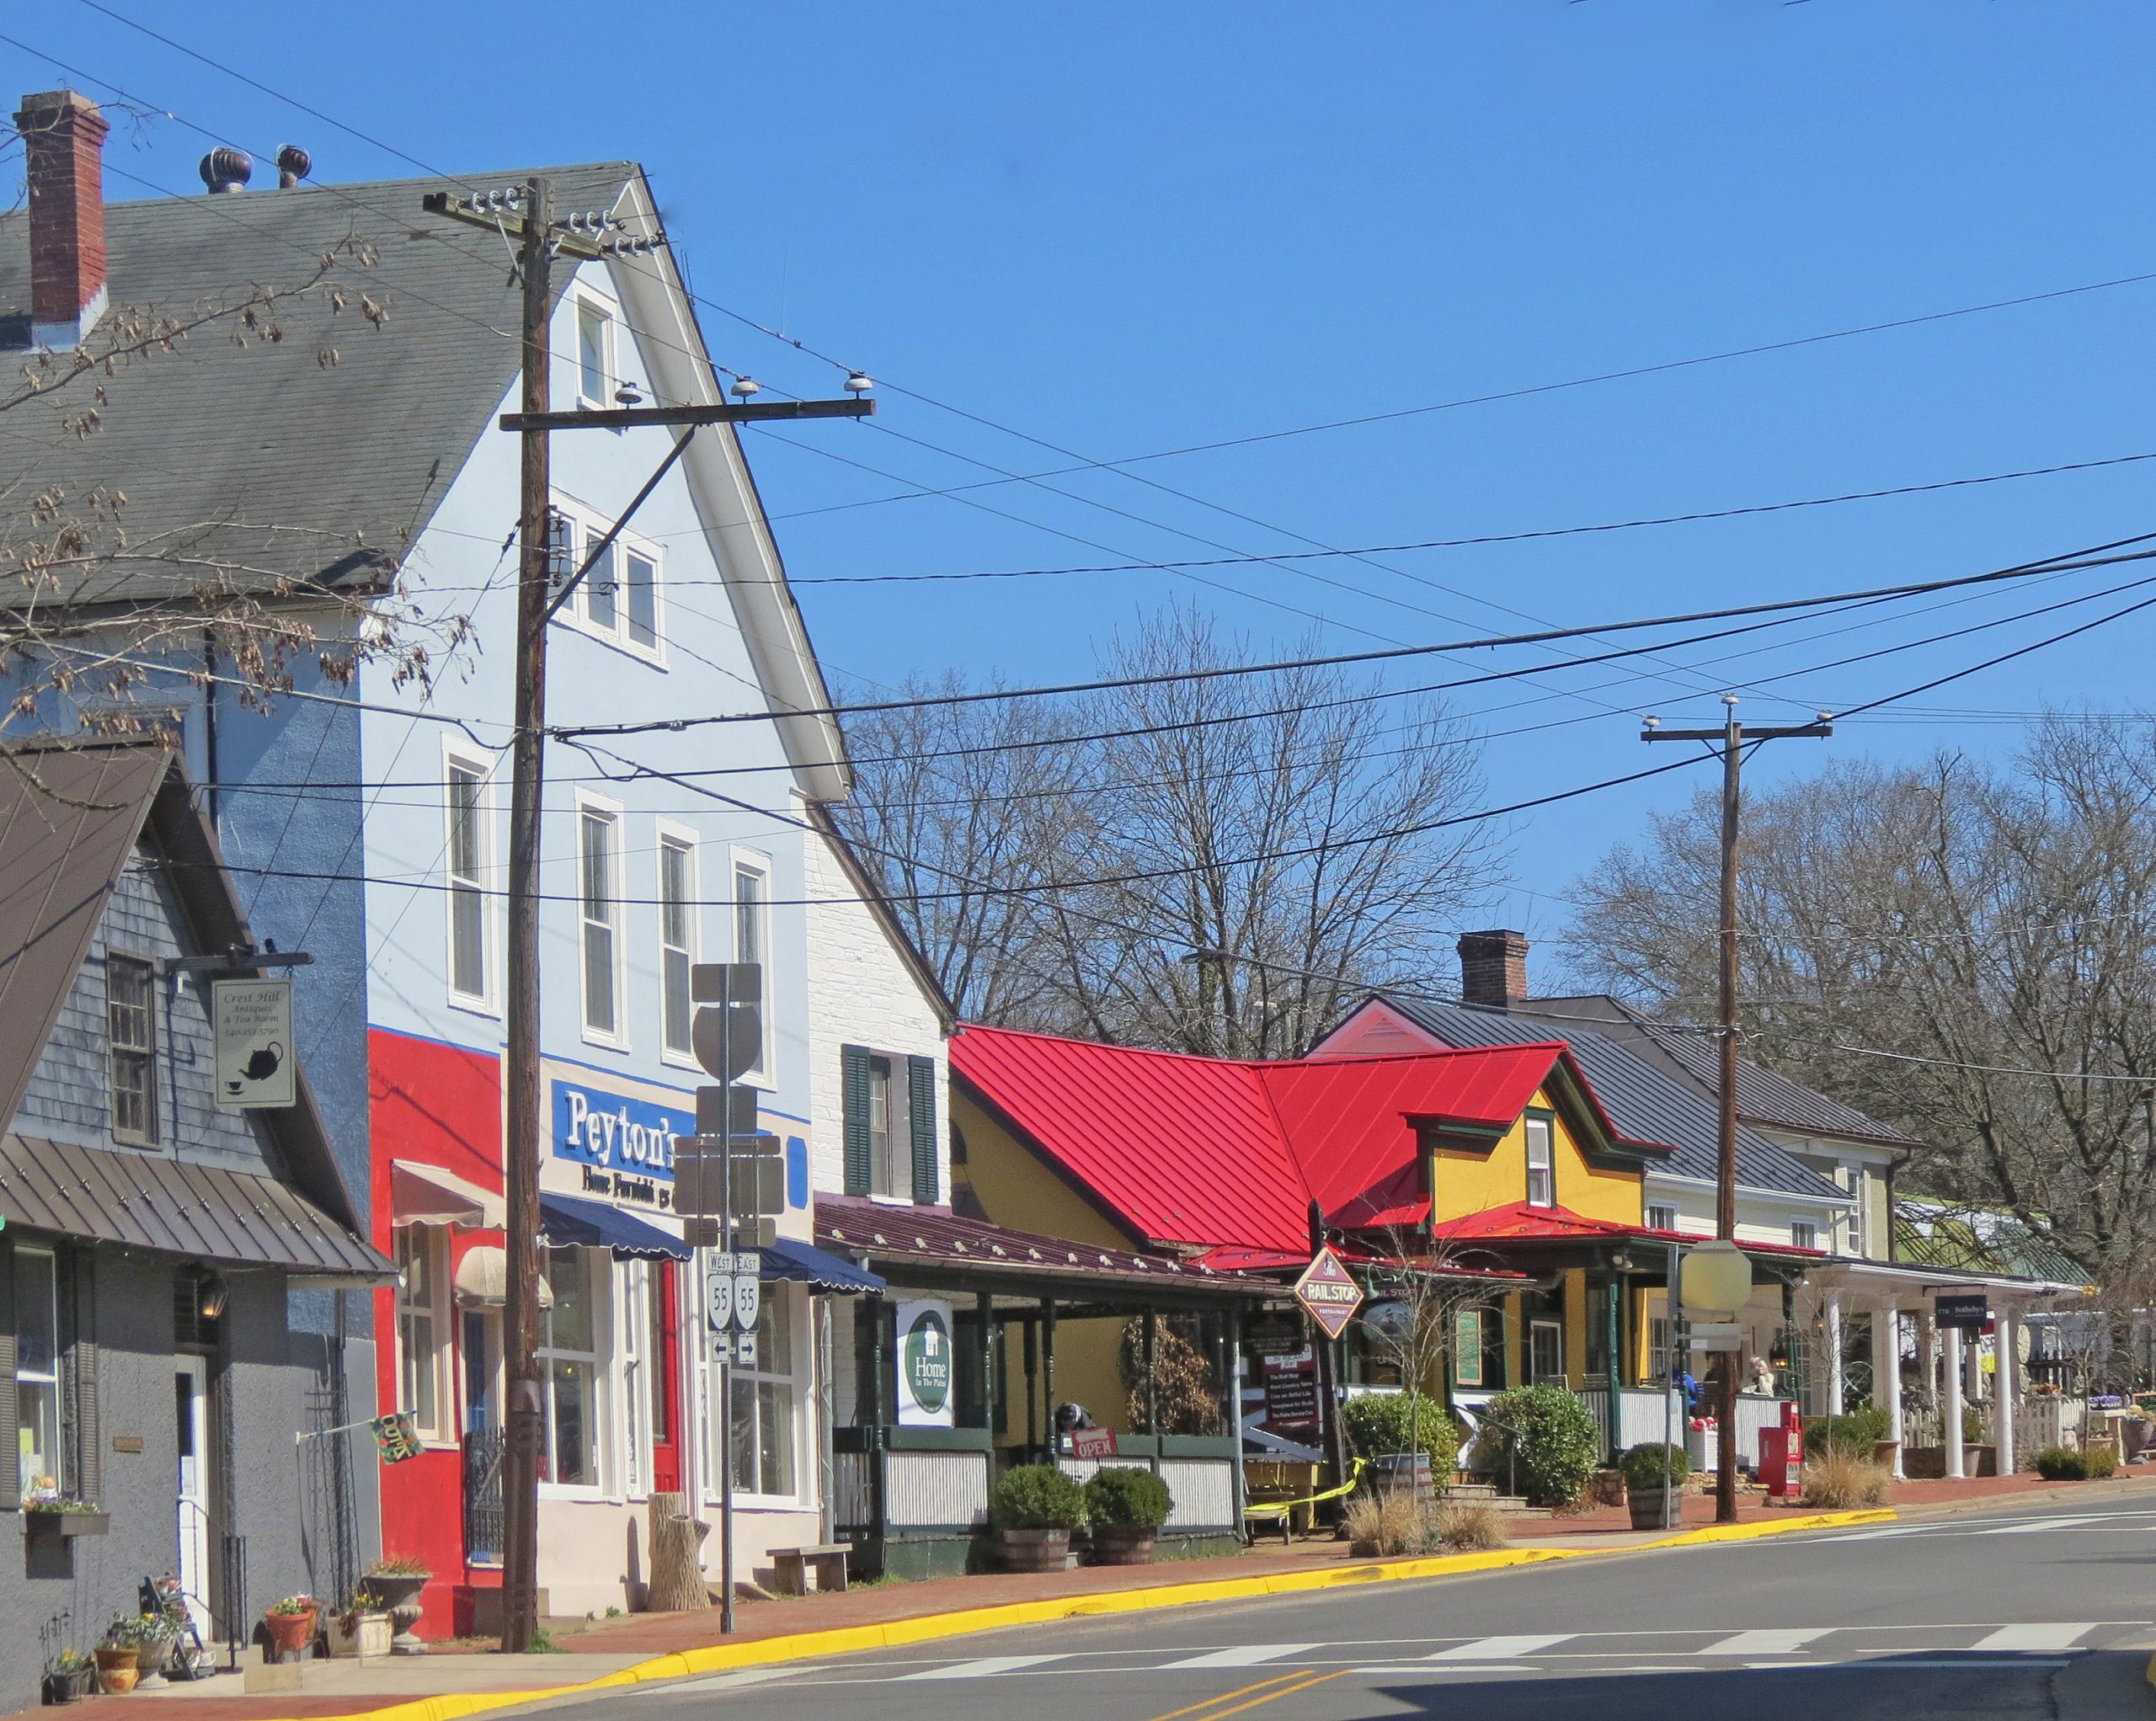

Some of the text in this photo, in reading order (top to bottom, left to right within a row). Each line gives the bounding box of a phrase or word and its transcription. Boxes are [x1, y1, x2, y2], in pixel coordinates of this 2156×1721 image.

[224, 990, 283, 1004] Crest Hill
[234, 1004, 271, 1015] Antiques
[234, 1015, 251, 1023] Tea
[565, 1090, 680, 1169] Peyton's
[582, 1164, 611, 1195] Home
[710, 1254, 730, 1269] WEST
[737, 1255, 757, 1270] EAST
[1323, 1260, 1337, 1277] The
[714, 1287, 728, 1310] 55
[741, 1287, 755, 1311] 55
[1307, 1284, 1357, 1302] RAIL STOP
[915, 1356, 947, 1378] Home
[923, 1377, 933, 1387] The
[1078, 1440, 1113, 1457] OPEN
